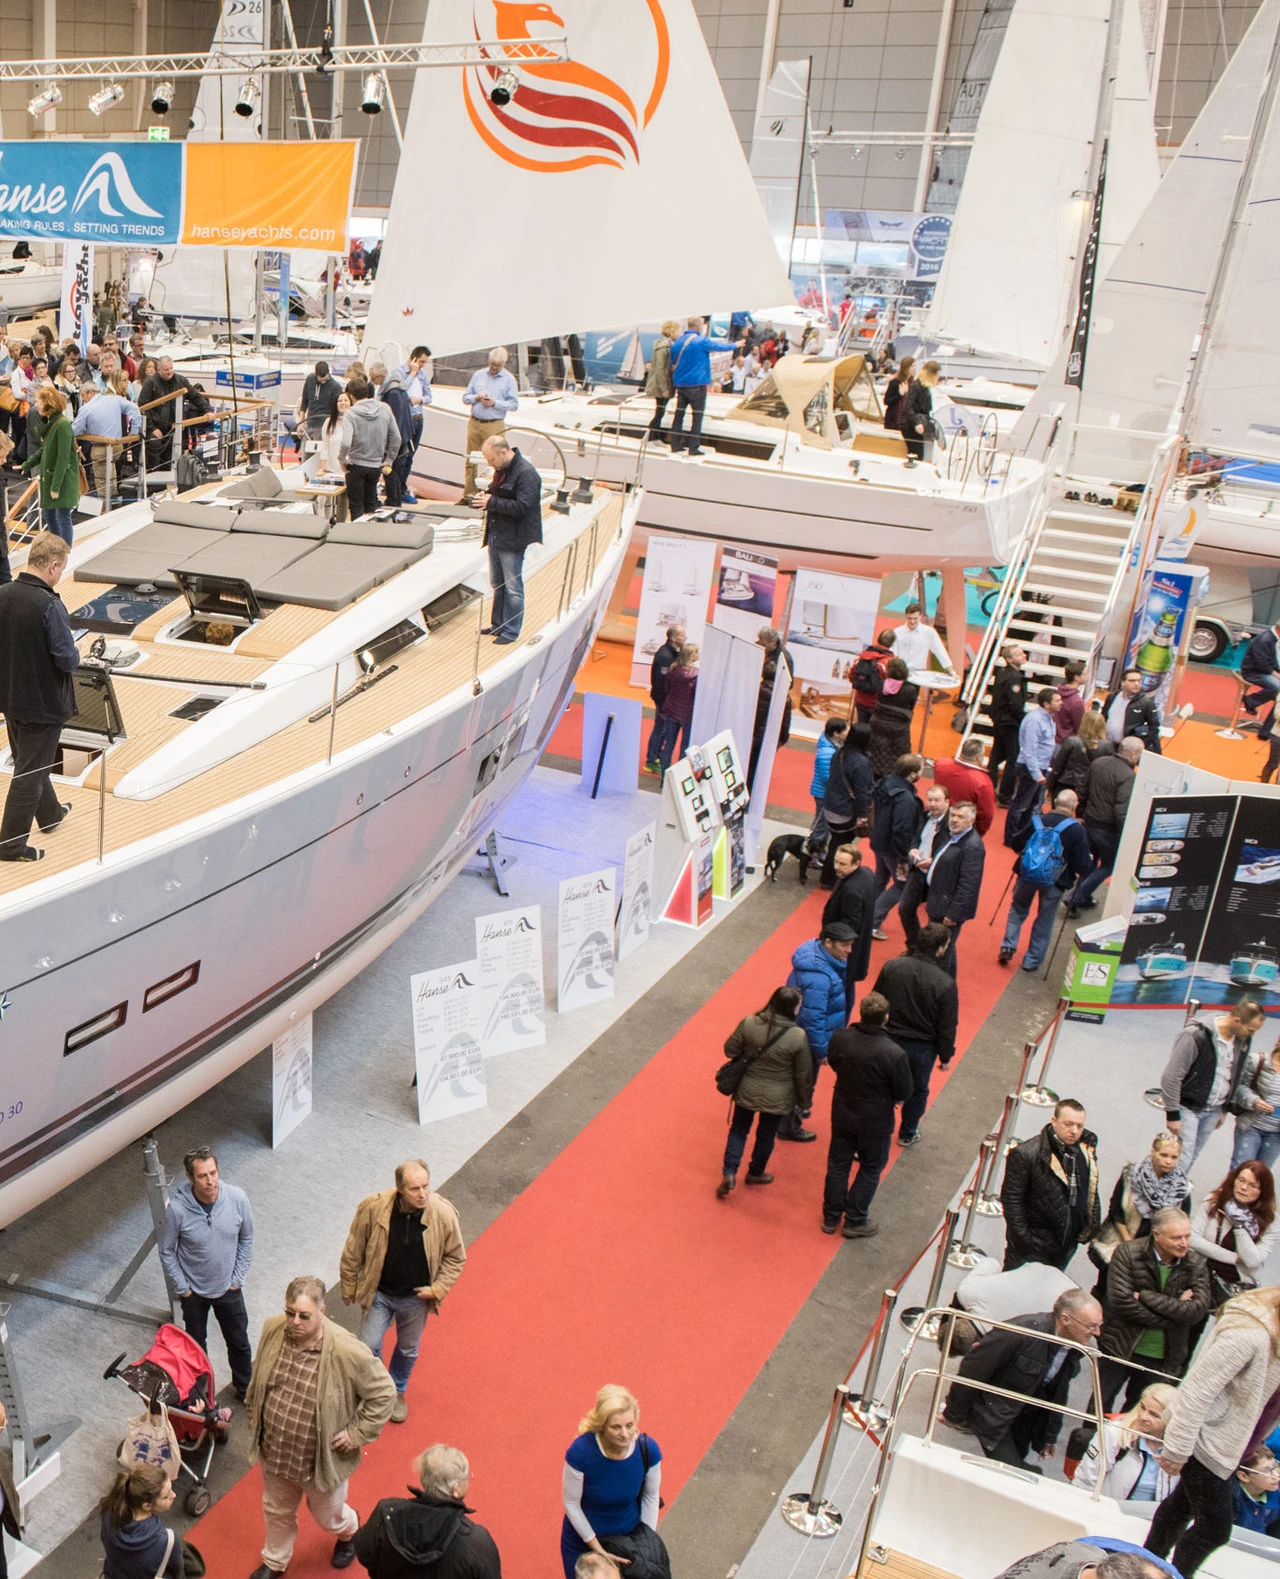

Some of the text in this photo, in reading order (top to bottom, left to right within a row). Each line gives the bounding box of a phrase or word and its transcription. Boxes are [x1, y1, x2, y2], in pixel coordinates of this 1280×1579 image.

[248, 2, 262, 13] 26
[960, 83, 986, 97] AUT
[34, 220, 65, 232] RULES
[73, 222, 119, 235] SETTING
[121, 224, 165, 237] TRENDS
[190, 222, 335, 242] hanseyachts.com
[481, 923, 512, 943] Hanse
[416, 980, 449, 1002] Hanse
[467, 1046, 481, 1056] EUR
[469, 1066, 482, 1076] EUR
[7, 1100, 24, 1123] 30
